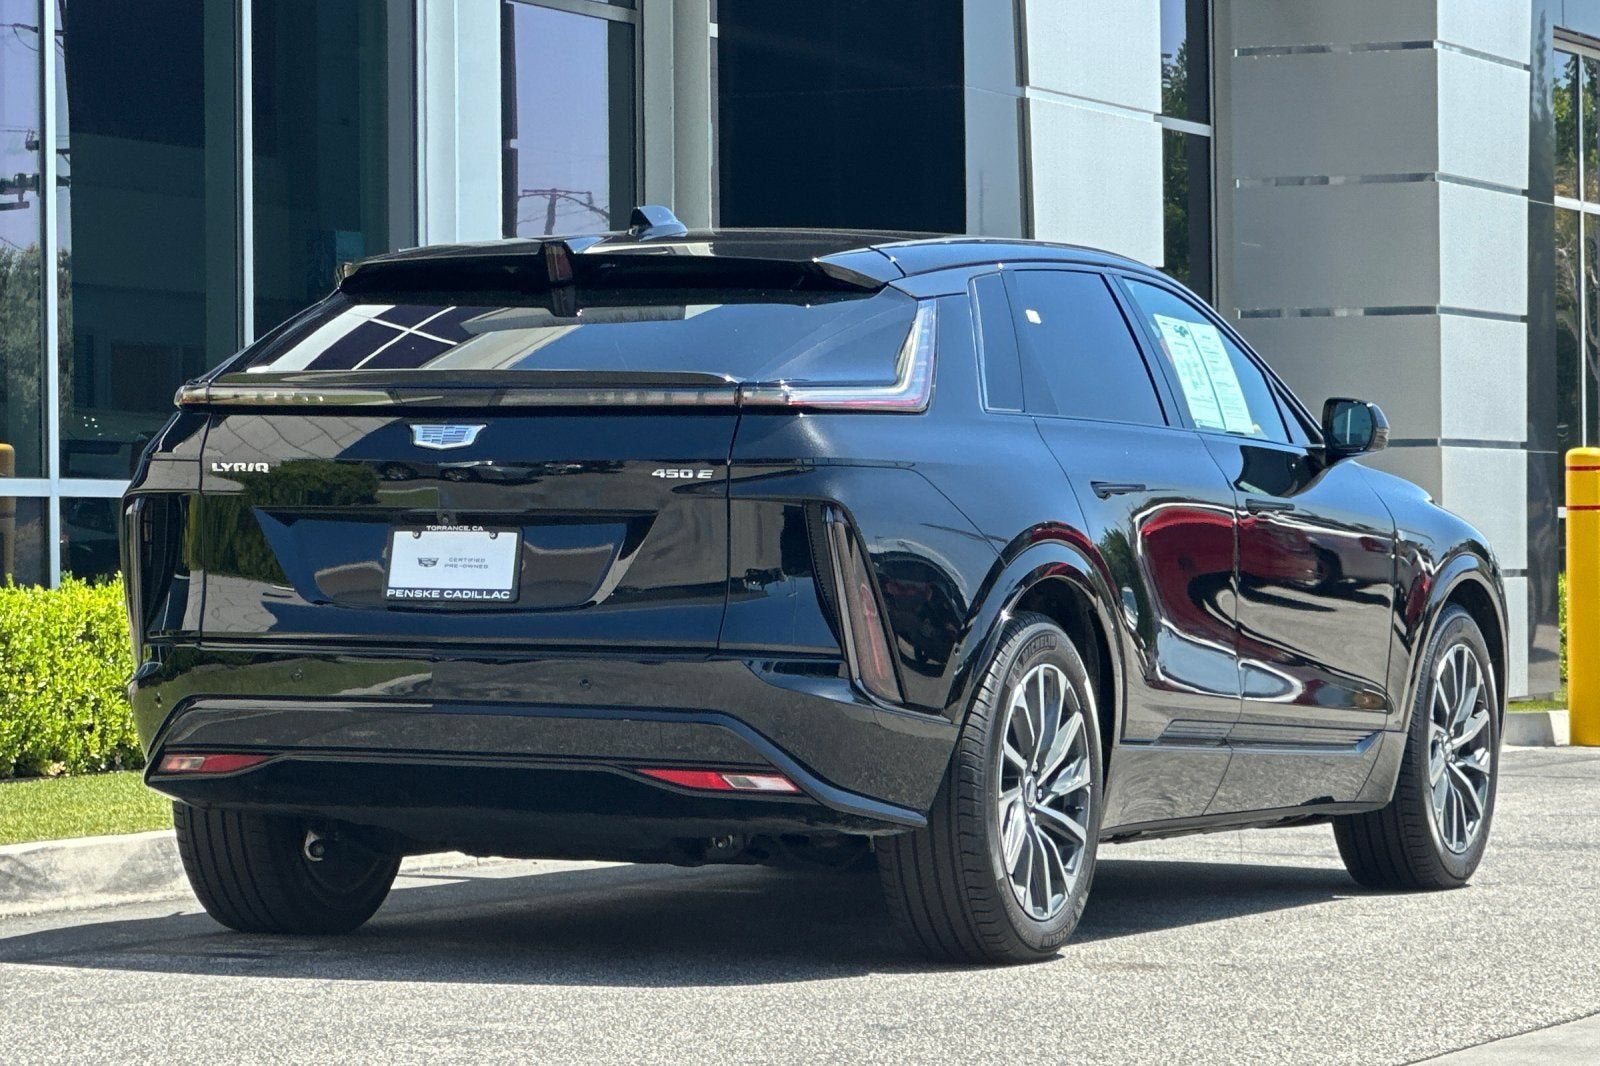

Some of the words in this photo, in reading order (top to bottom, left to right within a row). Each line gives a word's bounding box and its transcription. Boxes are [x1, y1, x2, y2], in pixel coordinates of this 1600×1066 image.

[211, 462, 270, 473] LYRIQ
[651, 469, 693, 478] 450
[697, 469, 714, 478] E
[386, 589, 440, 598] PENSKE
[443, 590, 510, 599] CADILLAC
[1022, 633, 1057, 663] MICHELIN
